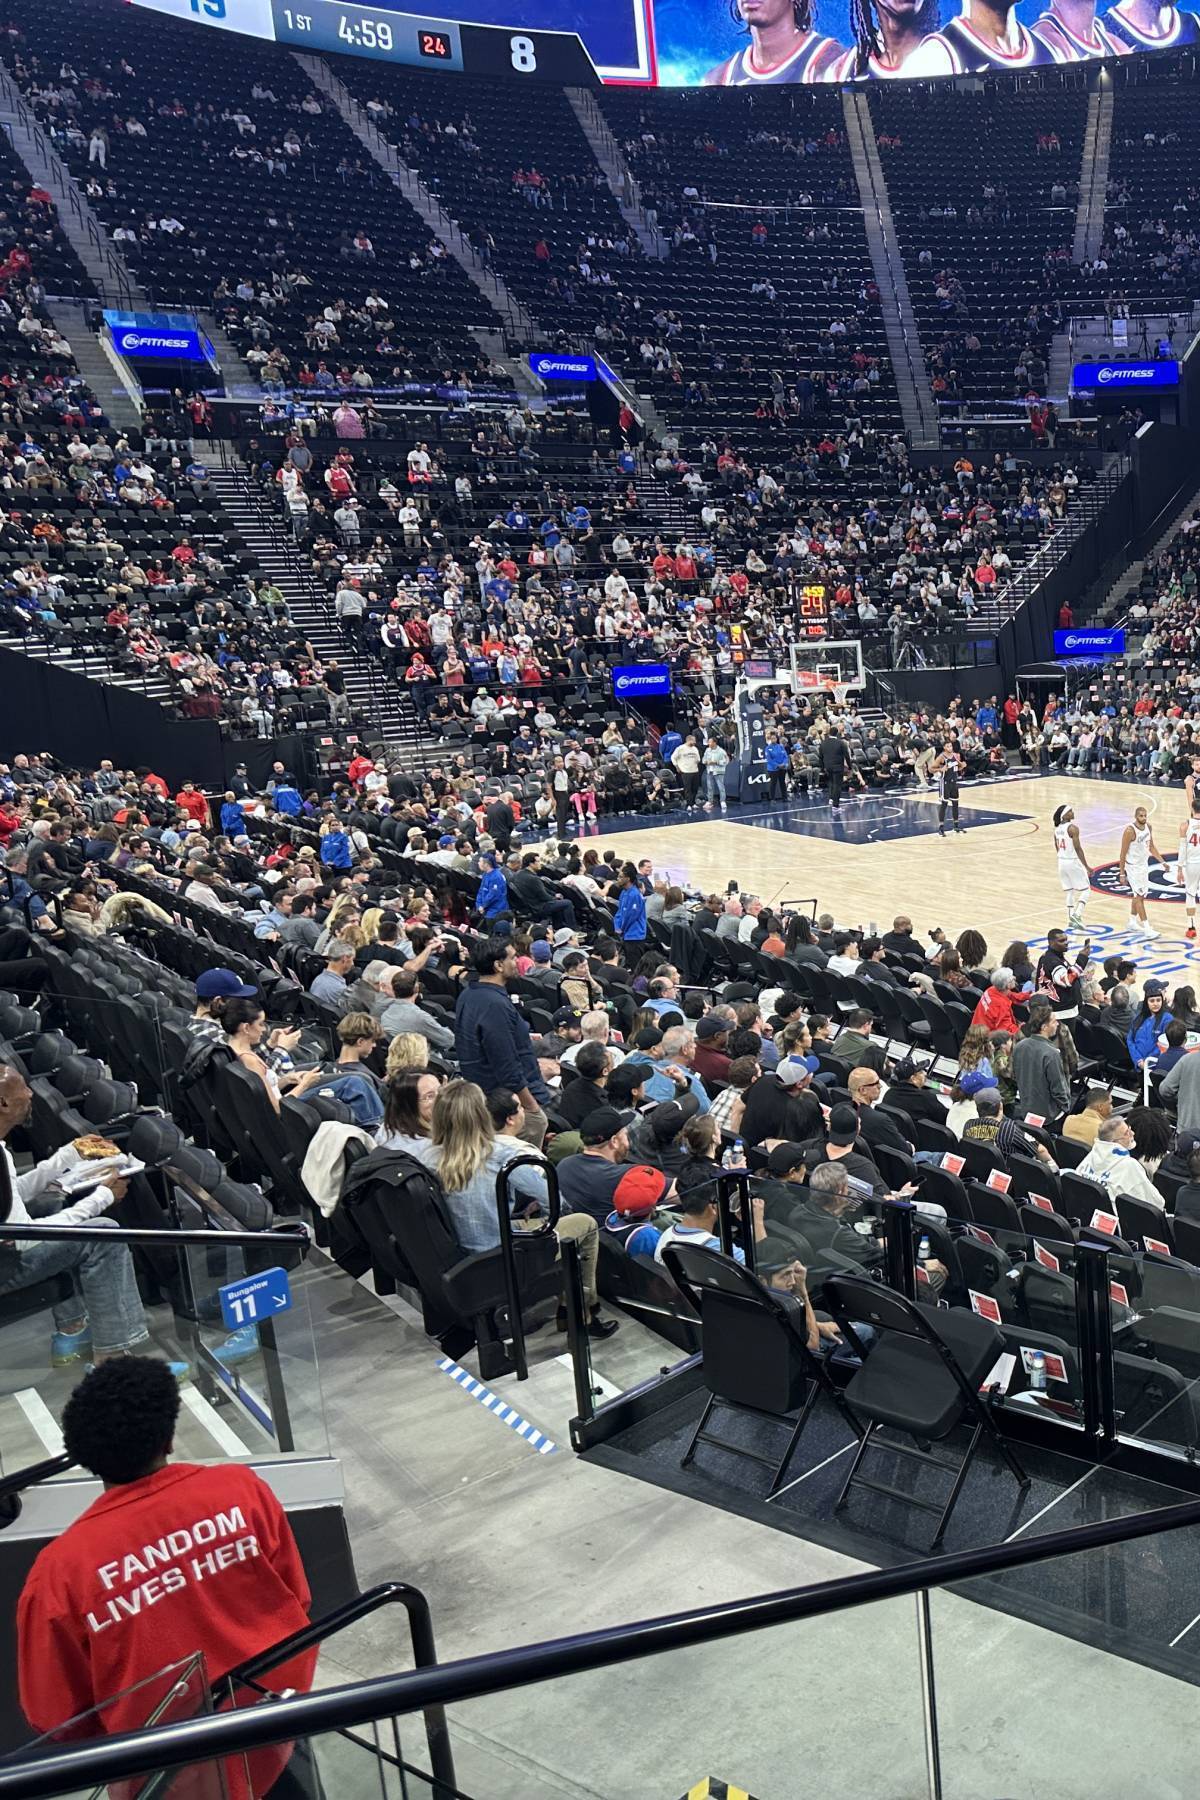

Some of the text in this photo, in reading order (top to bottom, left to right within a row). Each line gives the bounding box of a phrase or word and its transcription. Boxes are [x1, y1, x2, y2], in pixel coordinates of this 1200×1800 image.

[338, 16, 393, 50] 4:59
[423, 35, 445, 55] 24
[510, 36, 537, 72] 8
[140, 338, 190, 348] FITNESS
[551, 363, 589, 372] FITNESS
[1112, 369, 1155, 378] FITNESS
[800, 597, 824, 616] 24
[1077, 636, 1114, 645] FITNESS
[629, 675, 667, 685] FITNESS
[227, 1279, 269, 1300] Bungalow
[229, 1294, 257, 1323] 11
[98, 1505, 248, 1590] FANDOM
[87, 1535, 261, 1633] LIVES HER
